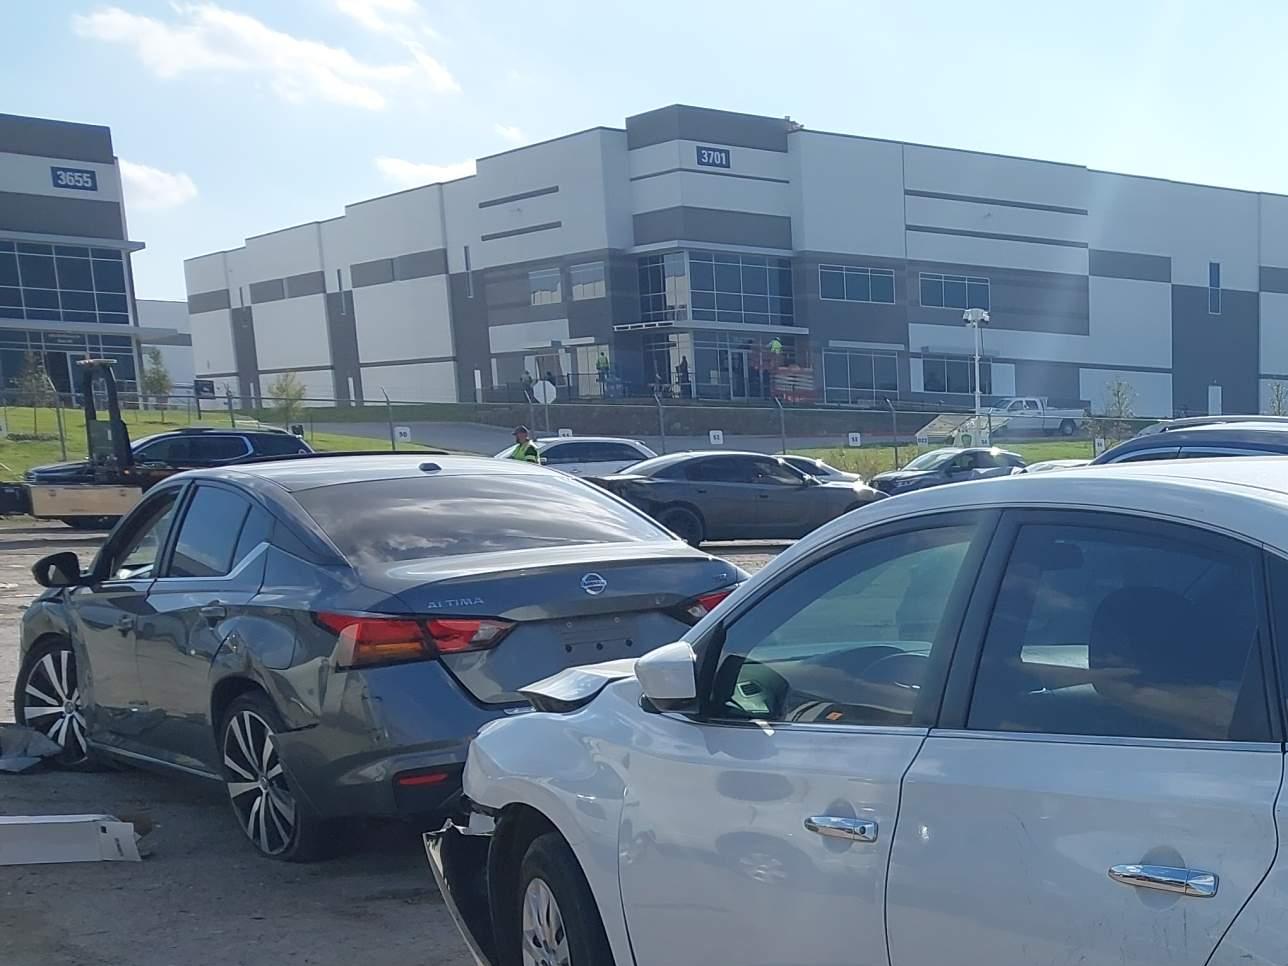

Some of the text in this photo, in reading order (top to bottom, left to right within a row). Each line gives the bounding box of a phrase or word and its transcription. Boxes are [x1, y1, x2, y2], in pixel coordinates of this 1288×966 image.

[701, 150, 726, 165] 3701
[56, 170, 92, 187] 3655
[427, 597, 485, 609] ALTIMA
